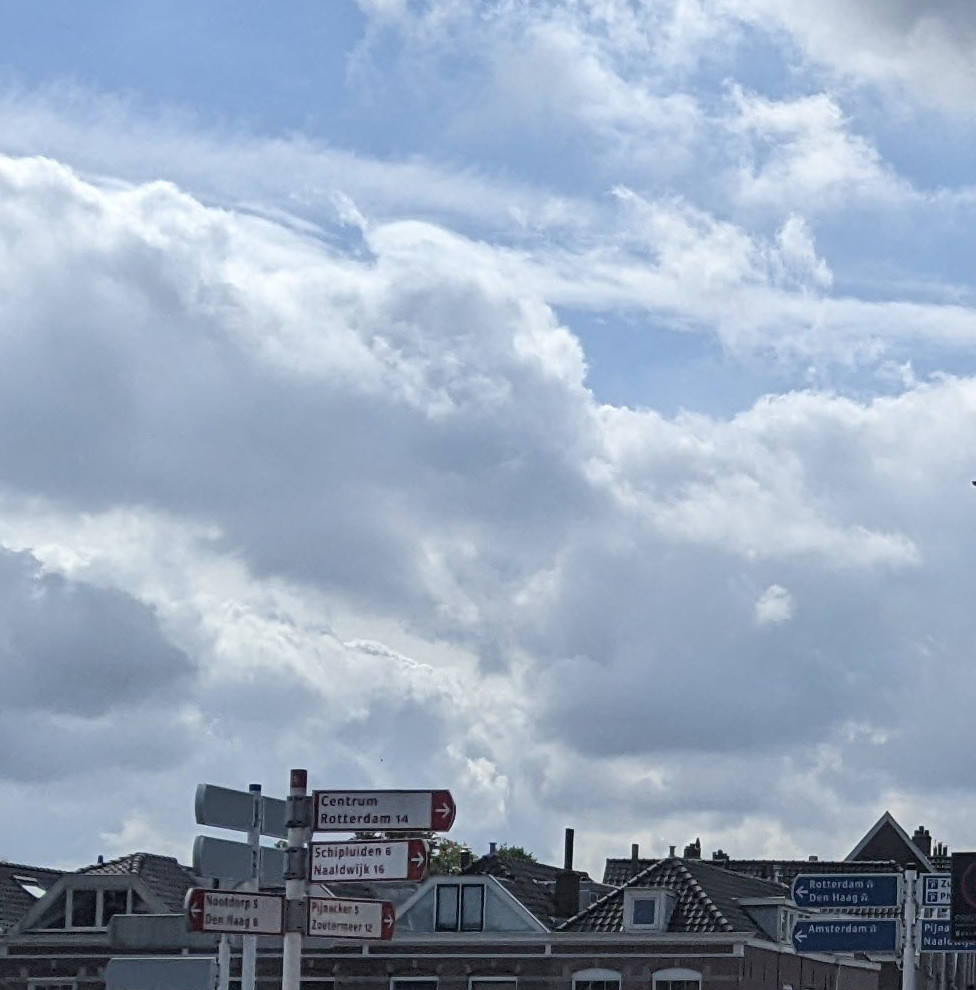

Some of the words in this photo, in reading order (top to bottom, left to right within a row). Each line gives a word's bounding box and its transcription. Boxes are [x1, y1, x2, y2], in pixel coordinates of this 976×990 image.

[321, 796, 378, 807] Centrum
[320, 813, 391, 824] Rotterdam
[397, 814, 409, 824] 14
[315, 846, 382, 859] Schipluiden
[385, 847, 392, 856] 6
[314, 864, 370, 877] Naaldwijk
[373, 865, 385, 874] 16
[809, 879, 864, 889] Rotterdam
[809, 893, 829, 902] Den
[832, 893, 858, 903] Haag
[808, 924, 867, 933] Amsterdam
